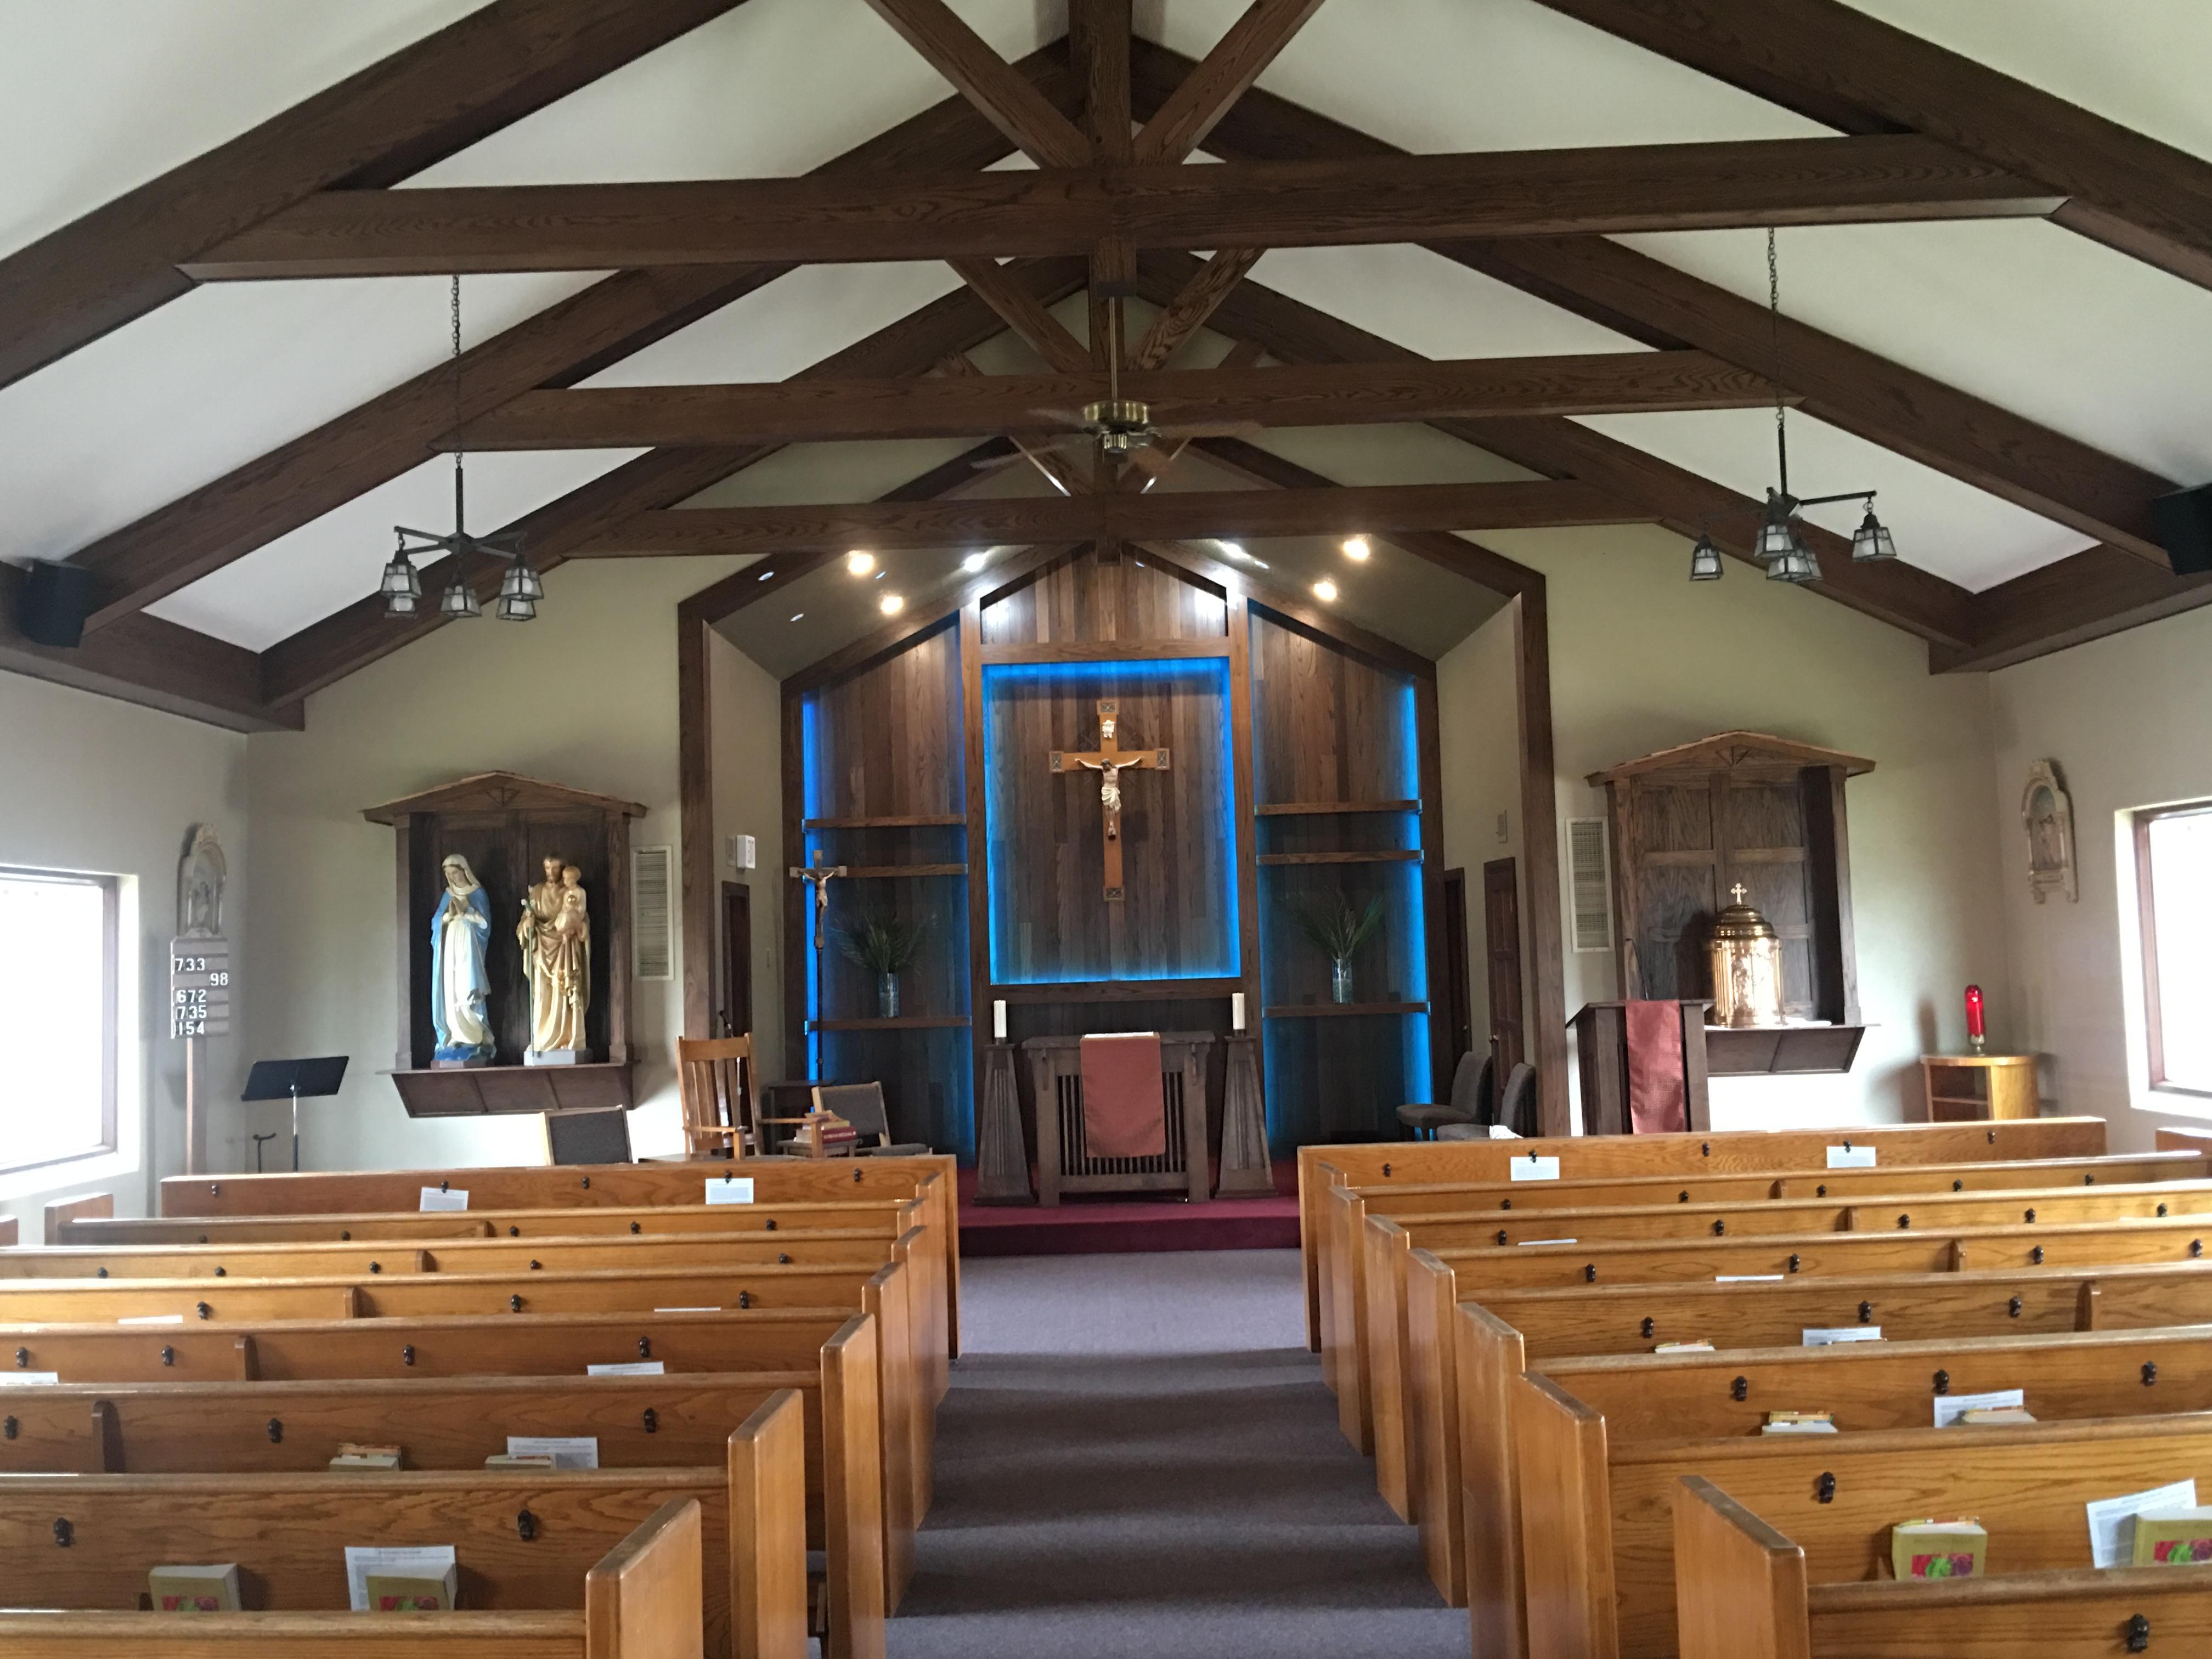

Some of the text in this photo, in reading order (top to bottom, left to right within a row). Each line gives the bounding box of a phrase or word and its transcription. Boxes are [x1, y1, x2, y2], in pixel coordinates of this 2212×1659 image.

[175, 957, 205, 972] 733
[210, 972, 228, 986] 98
[177, 989, 207, 1003] 672
[177, 1005, 207, 1019] 735
[179, 1021, 205, 1035] 154
